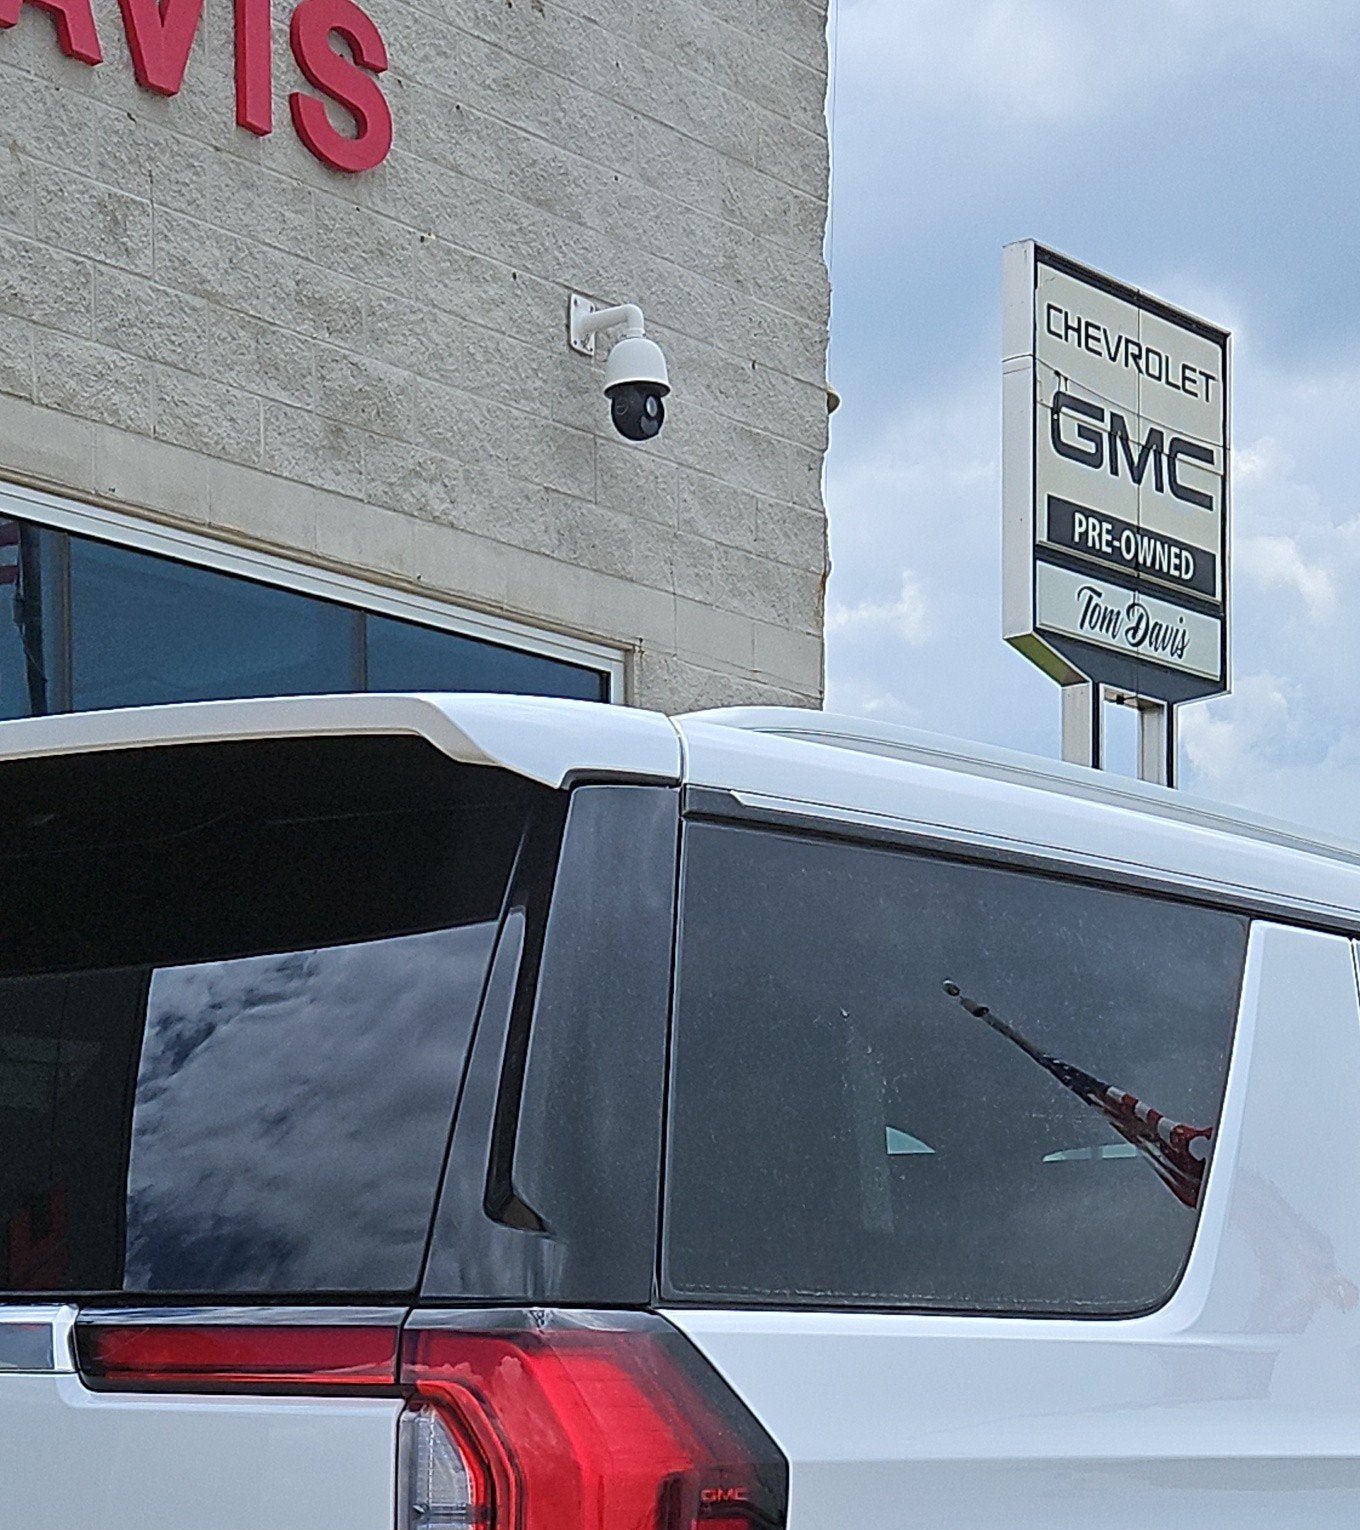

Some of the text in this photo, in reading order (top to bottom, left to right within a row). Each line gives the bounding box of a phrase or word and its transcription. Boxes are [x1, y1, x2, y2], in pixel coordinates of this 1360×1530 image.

[1045, 302, 1217, 403] CHEVROLET
[1050, 390, 1215, 512] GMC
[1073, 511, 1195, 581] PRE-OWNED
[1077, 585, 1191, 659] Tom Davis
[701, 1486, 751, 1502] GMC
